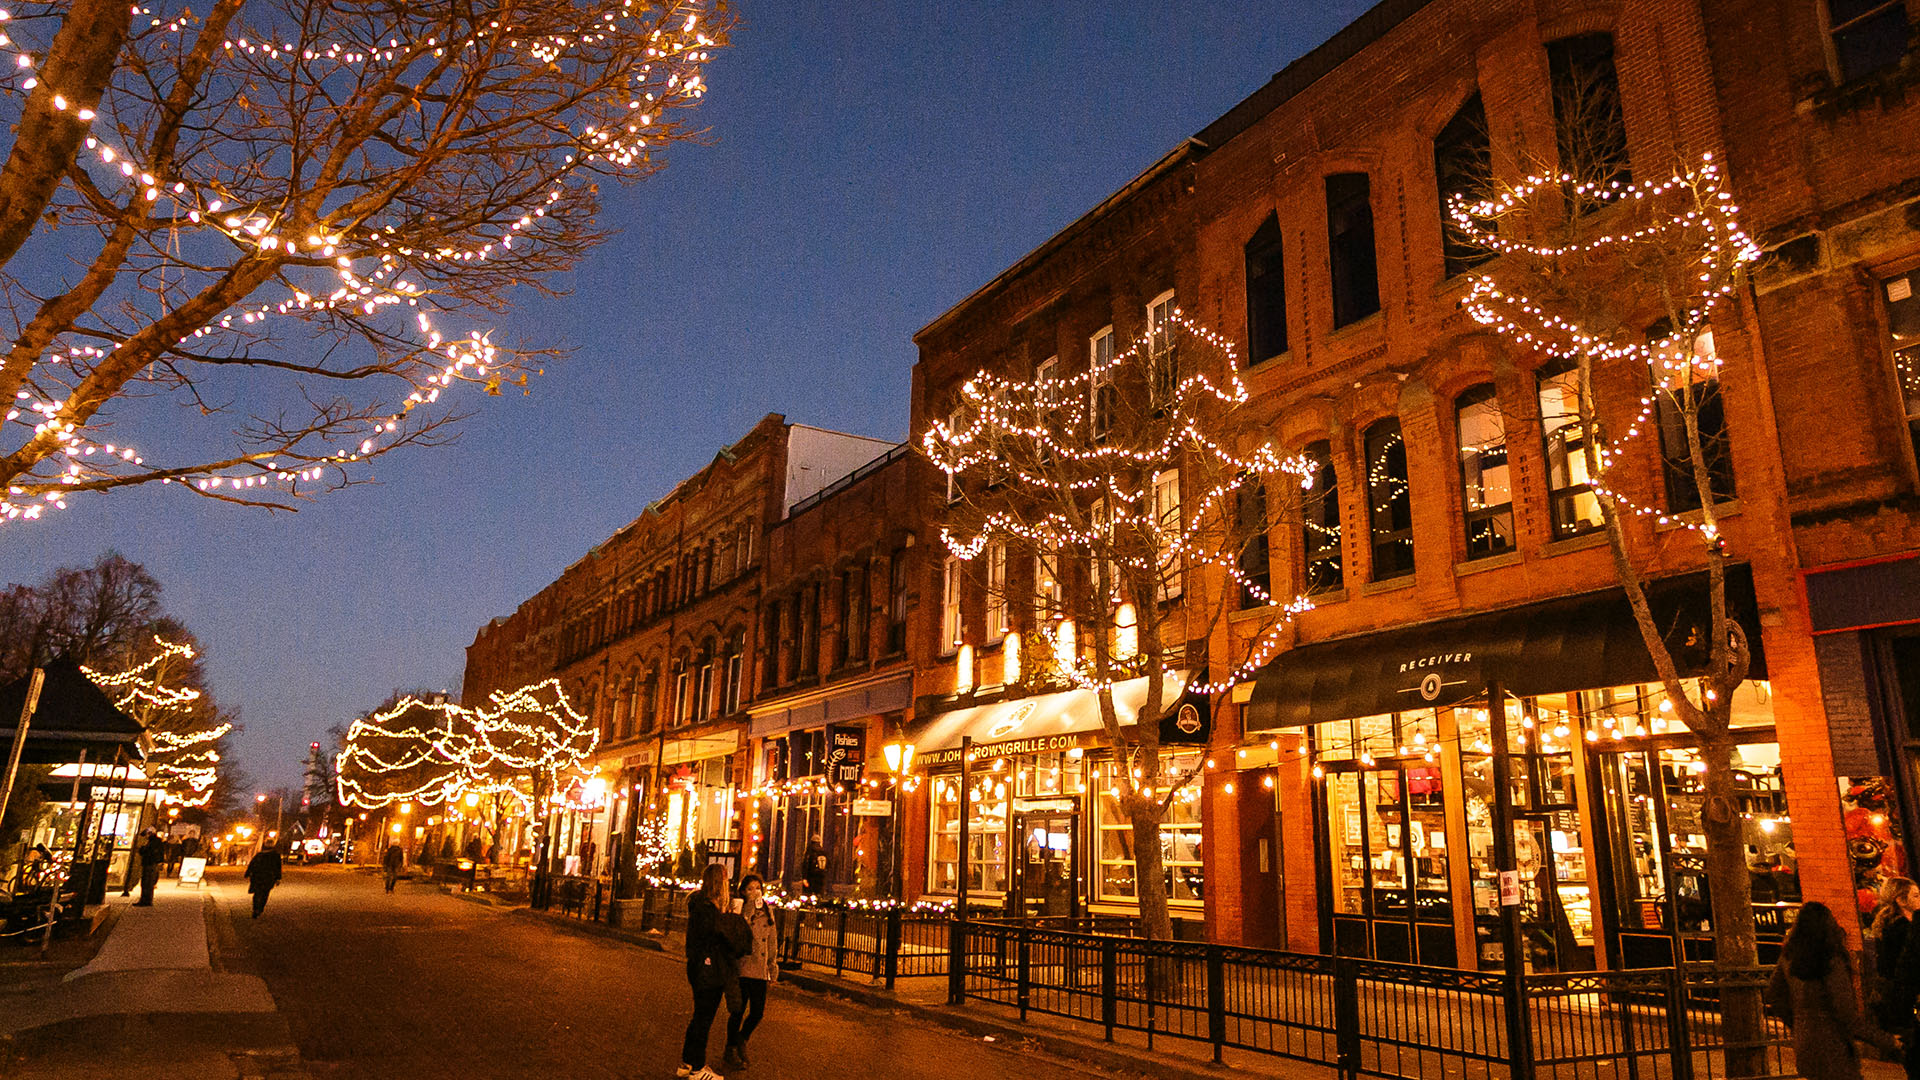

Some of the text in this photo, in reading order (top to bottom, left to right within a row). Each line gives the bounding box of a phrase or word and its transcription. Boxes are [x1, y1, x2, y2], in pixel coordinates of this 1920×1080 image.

[1399, 652, 1472, 673] RECEIVER
[916, 735, 1077, 765] WWW.JOHROWNGRILLE.COM
[839, 764, 860, 781] roof
